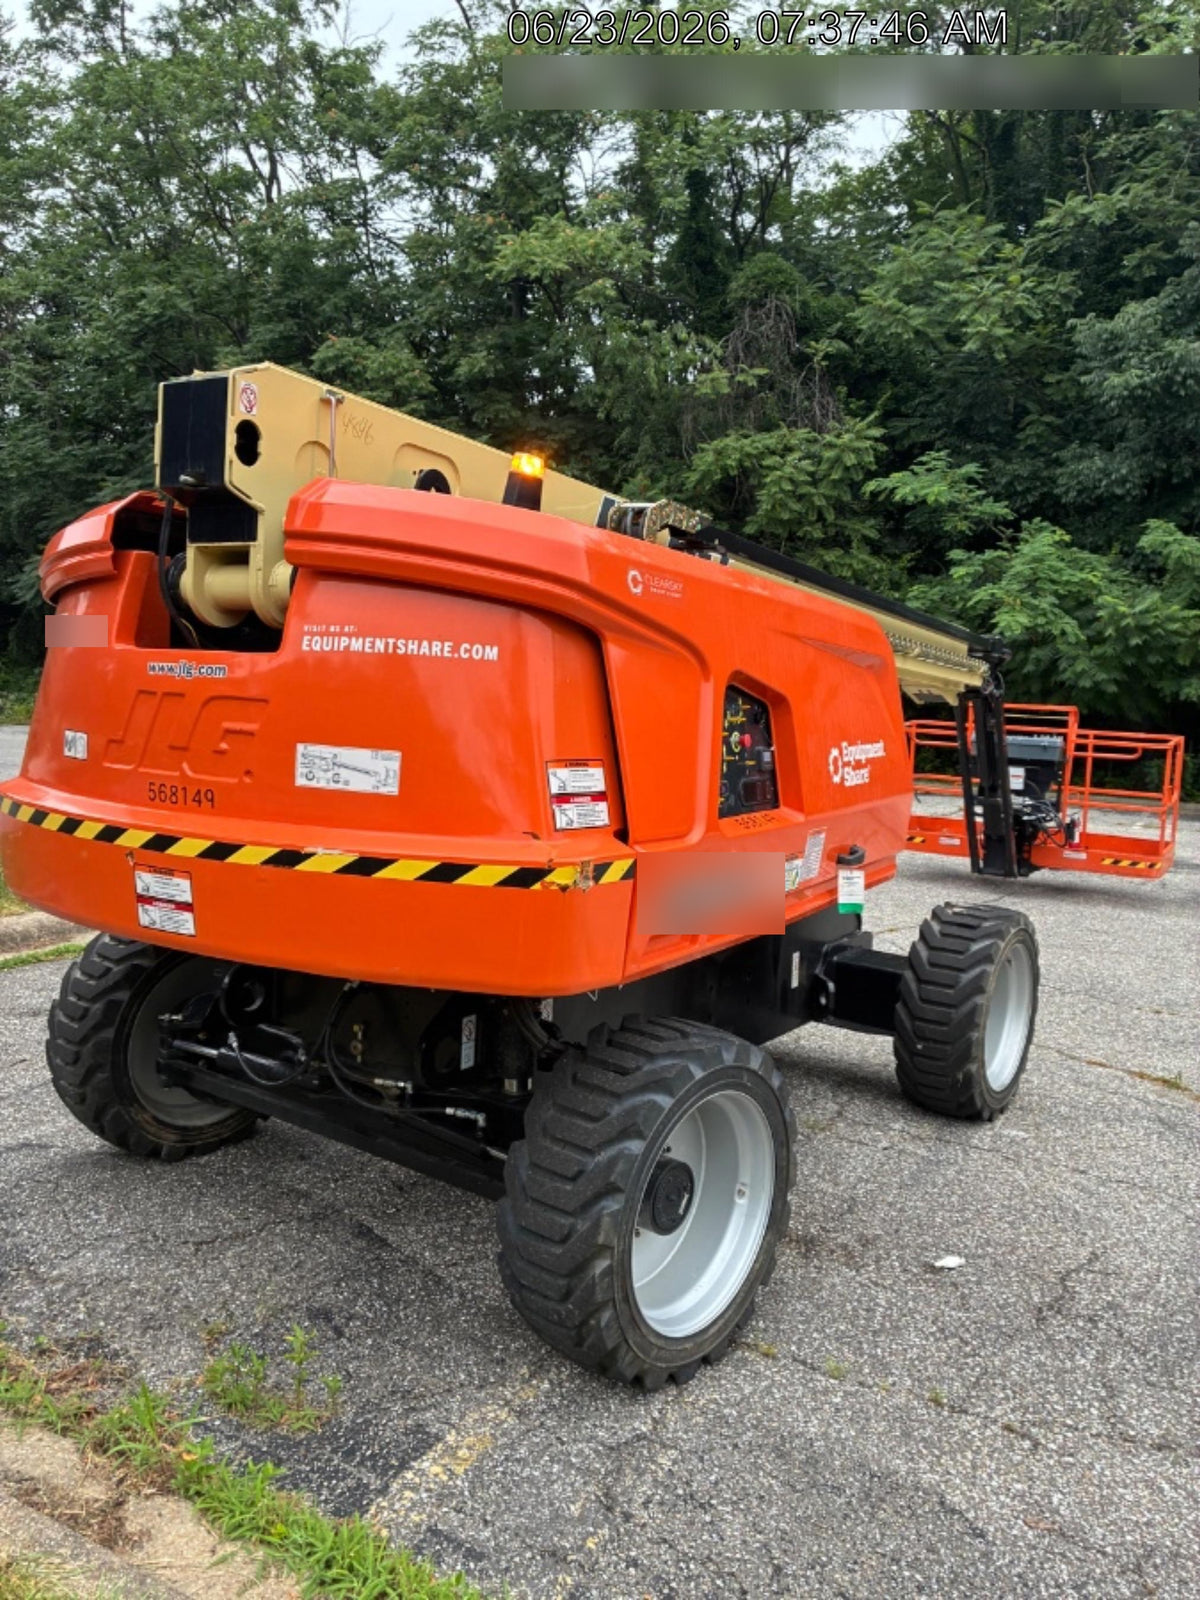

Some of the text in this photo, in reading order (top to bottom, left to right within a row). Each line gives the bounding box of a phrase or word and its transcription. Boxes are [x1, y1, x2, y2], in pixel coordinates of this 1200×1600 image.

[302, 635, 499, 661] EQUIPMENTSHARE.COM
[147, 660, 228, 679] www.jlg.com
[148, 782, 215, 808] 568149
